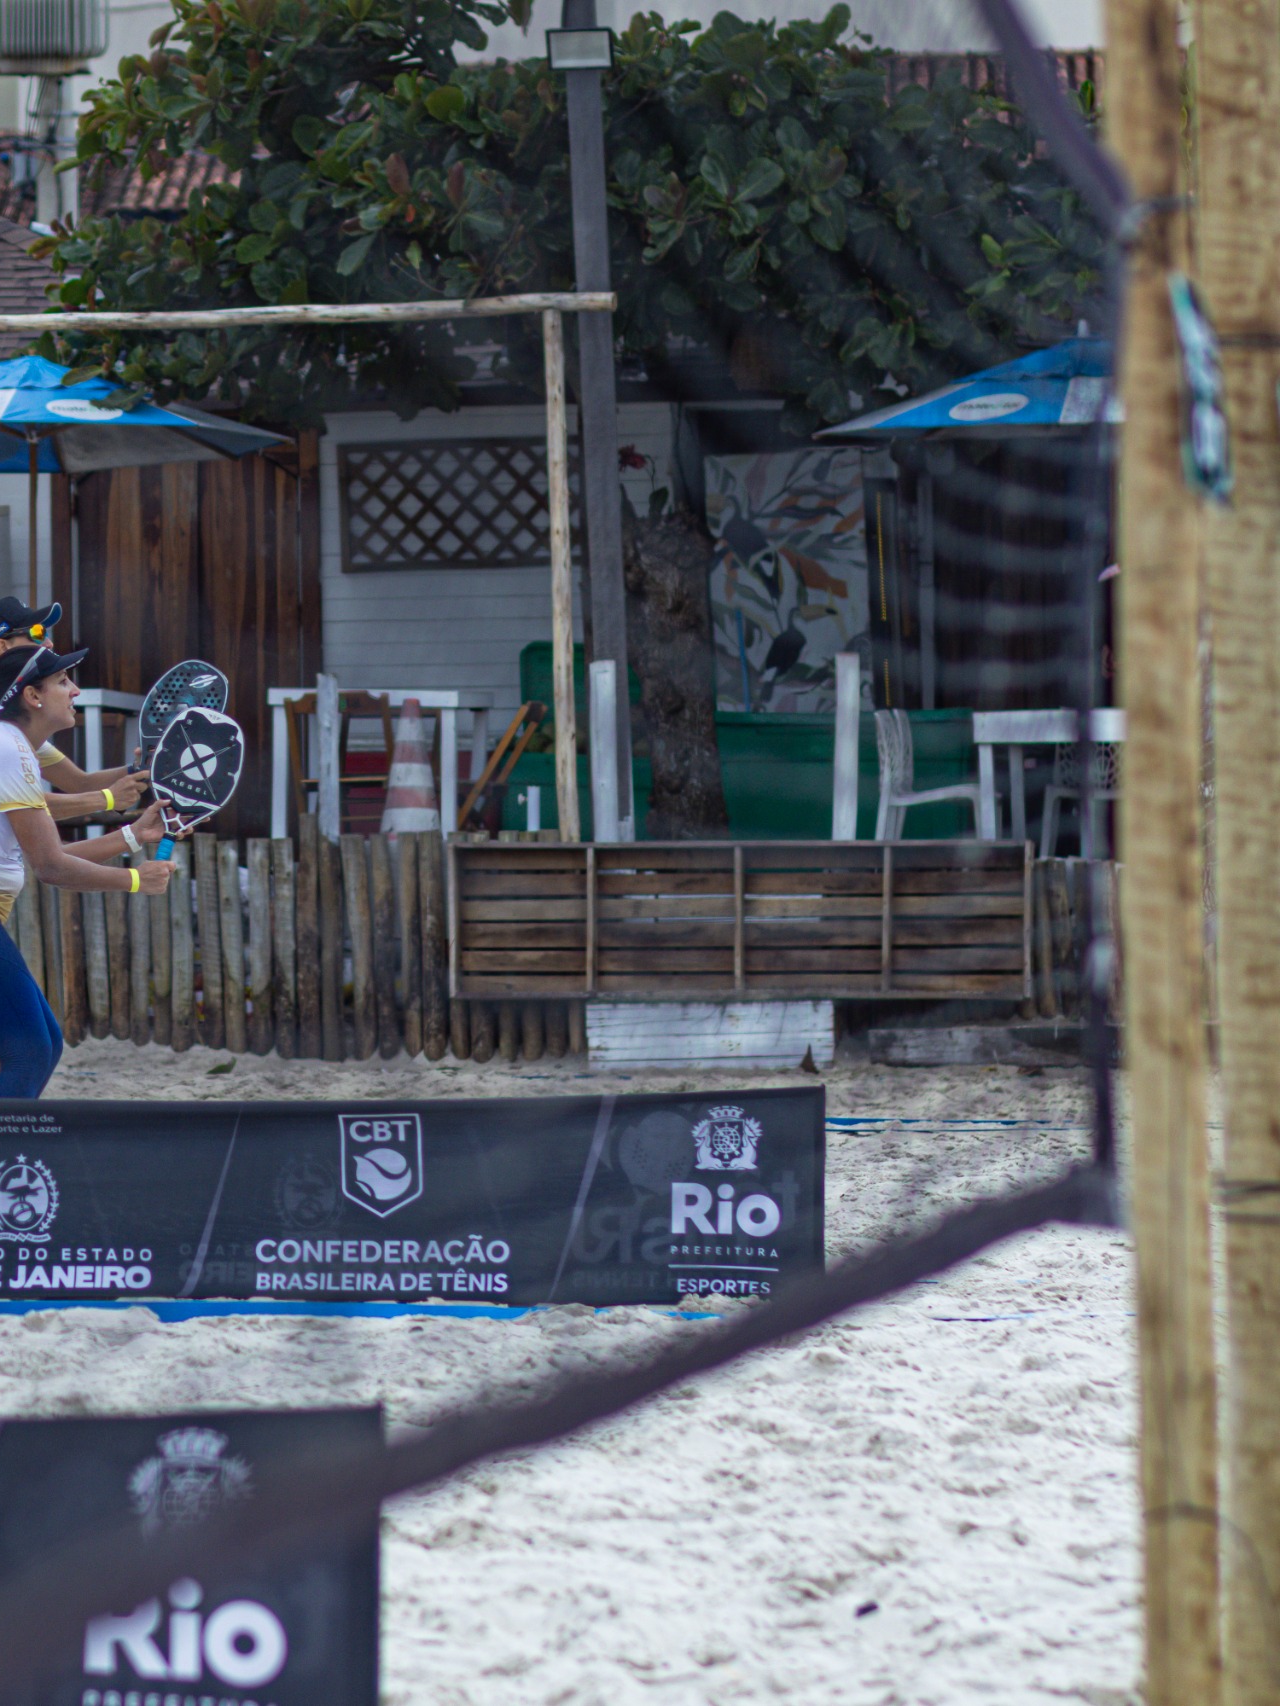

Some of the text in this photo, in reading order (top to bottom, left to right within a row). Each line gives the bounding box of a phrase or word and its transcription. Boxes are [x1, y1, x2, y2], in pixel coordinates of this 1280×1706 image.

[39, 1113, 55, 1123] de
[31, 1124, 63, 1134] Lazer
[349, 1120, 412, 1142] CBT
[671, 1182, 781, 1237] Rio
[18, 1247, 48, 1261] DO
[61, 1247, 152, 1262] ESTADO
[255, 1234, 511, 1266] CONFEDERAÇÃO
[670, 1245, 779, 1258] PREFEITURA
[9, 1265, 152, 1289] JANEIRO
[255, 1268, 509, 1293] BRASILEIRA DE TÊNIS
[676, 1278, 770, 1294] ESPORTES
